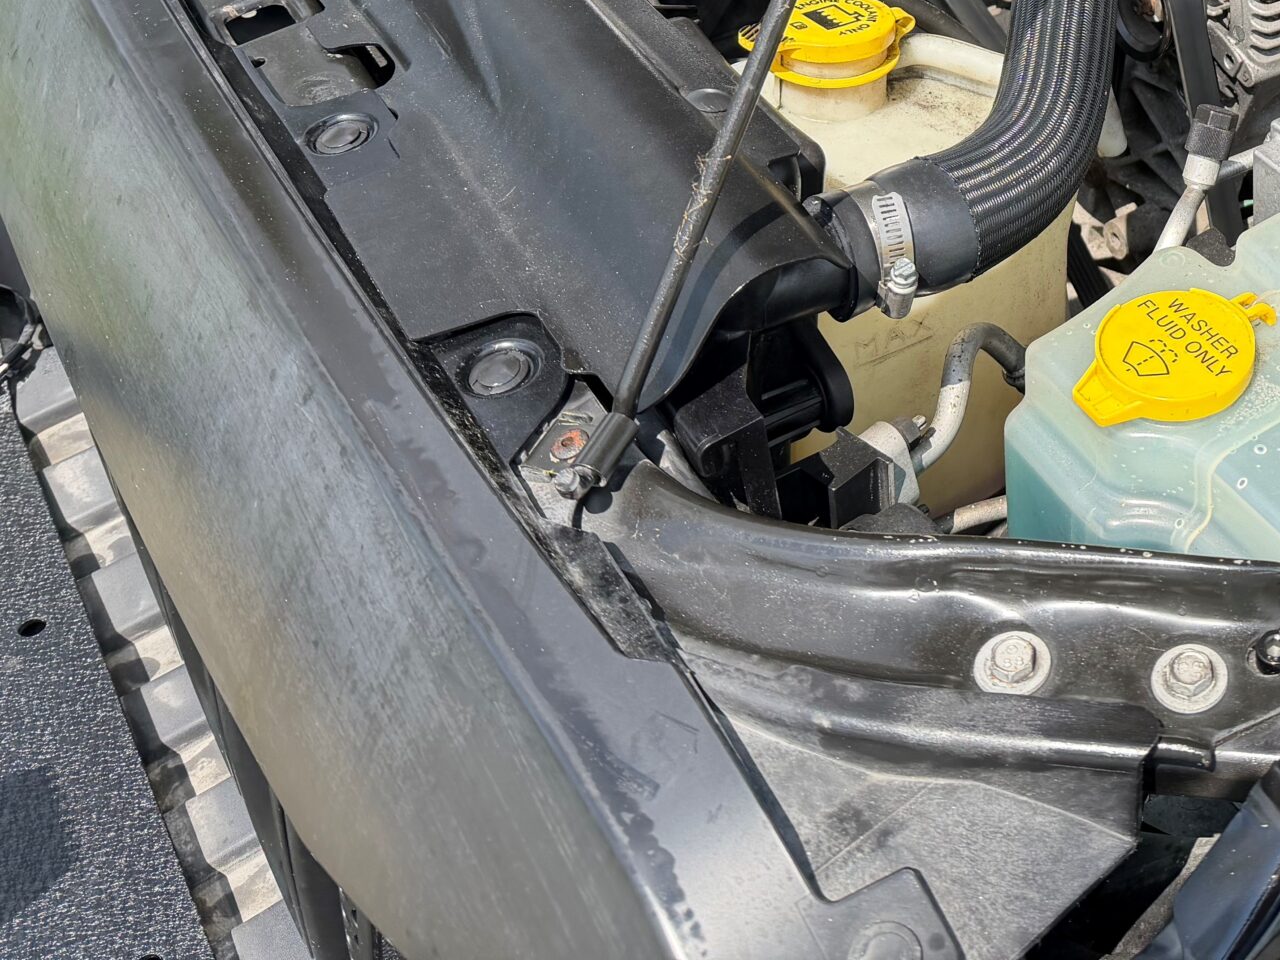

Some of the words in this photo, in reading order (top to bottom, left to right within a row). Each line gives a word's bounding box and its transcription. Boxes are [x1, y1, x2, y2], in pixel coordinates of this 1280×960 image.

[839, 23, 870, 36] ONLY
[1137, 299, 1186, 341] FLUID
[1184, 340, 1232, 377] ONLY
[1168, 297, 1238, 359] WASHER
